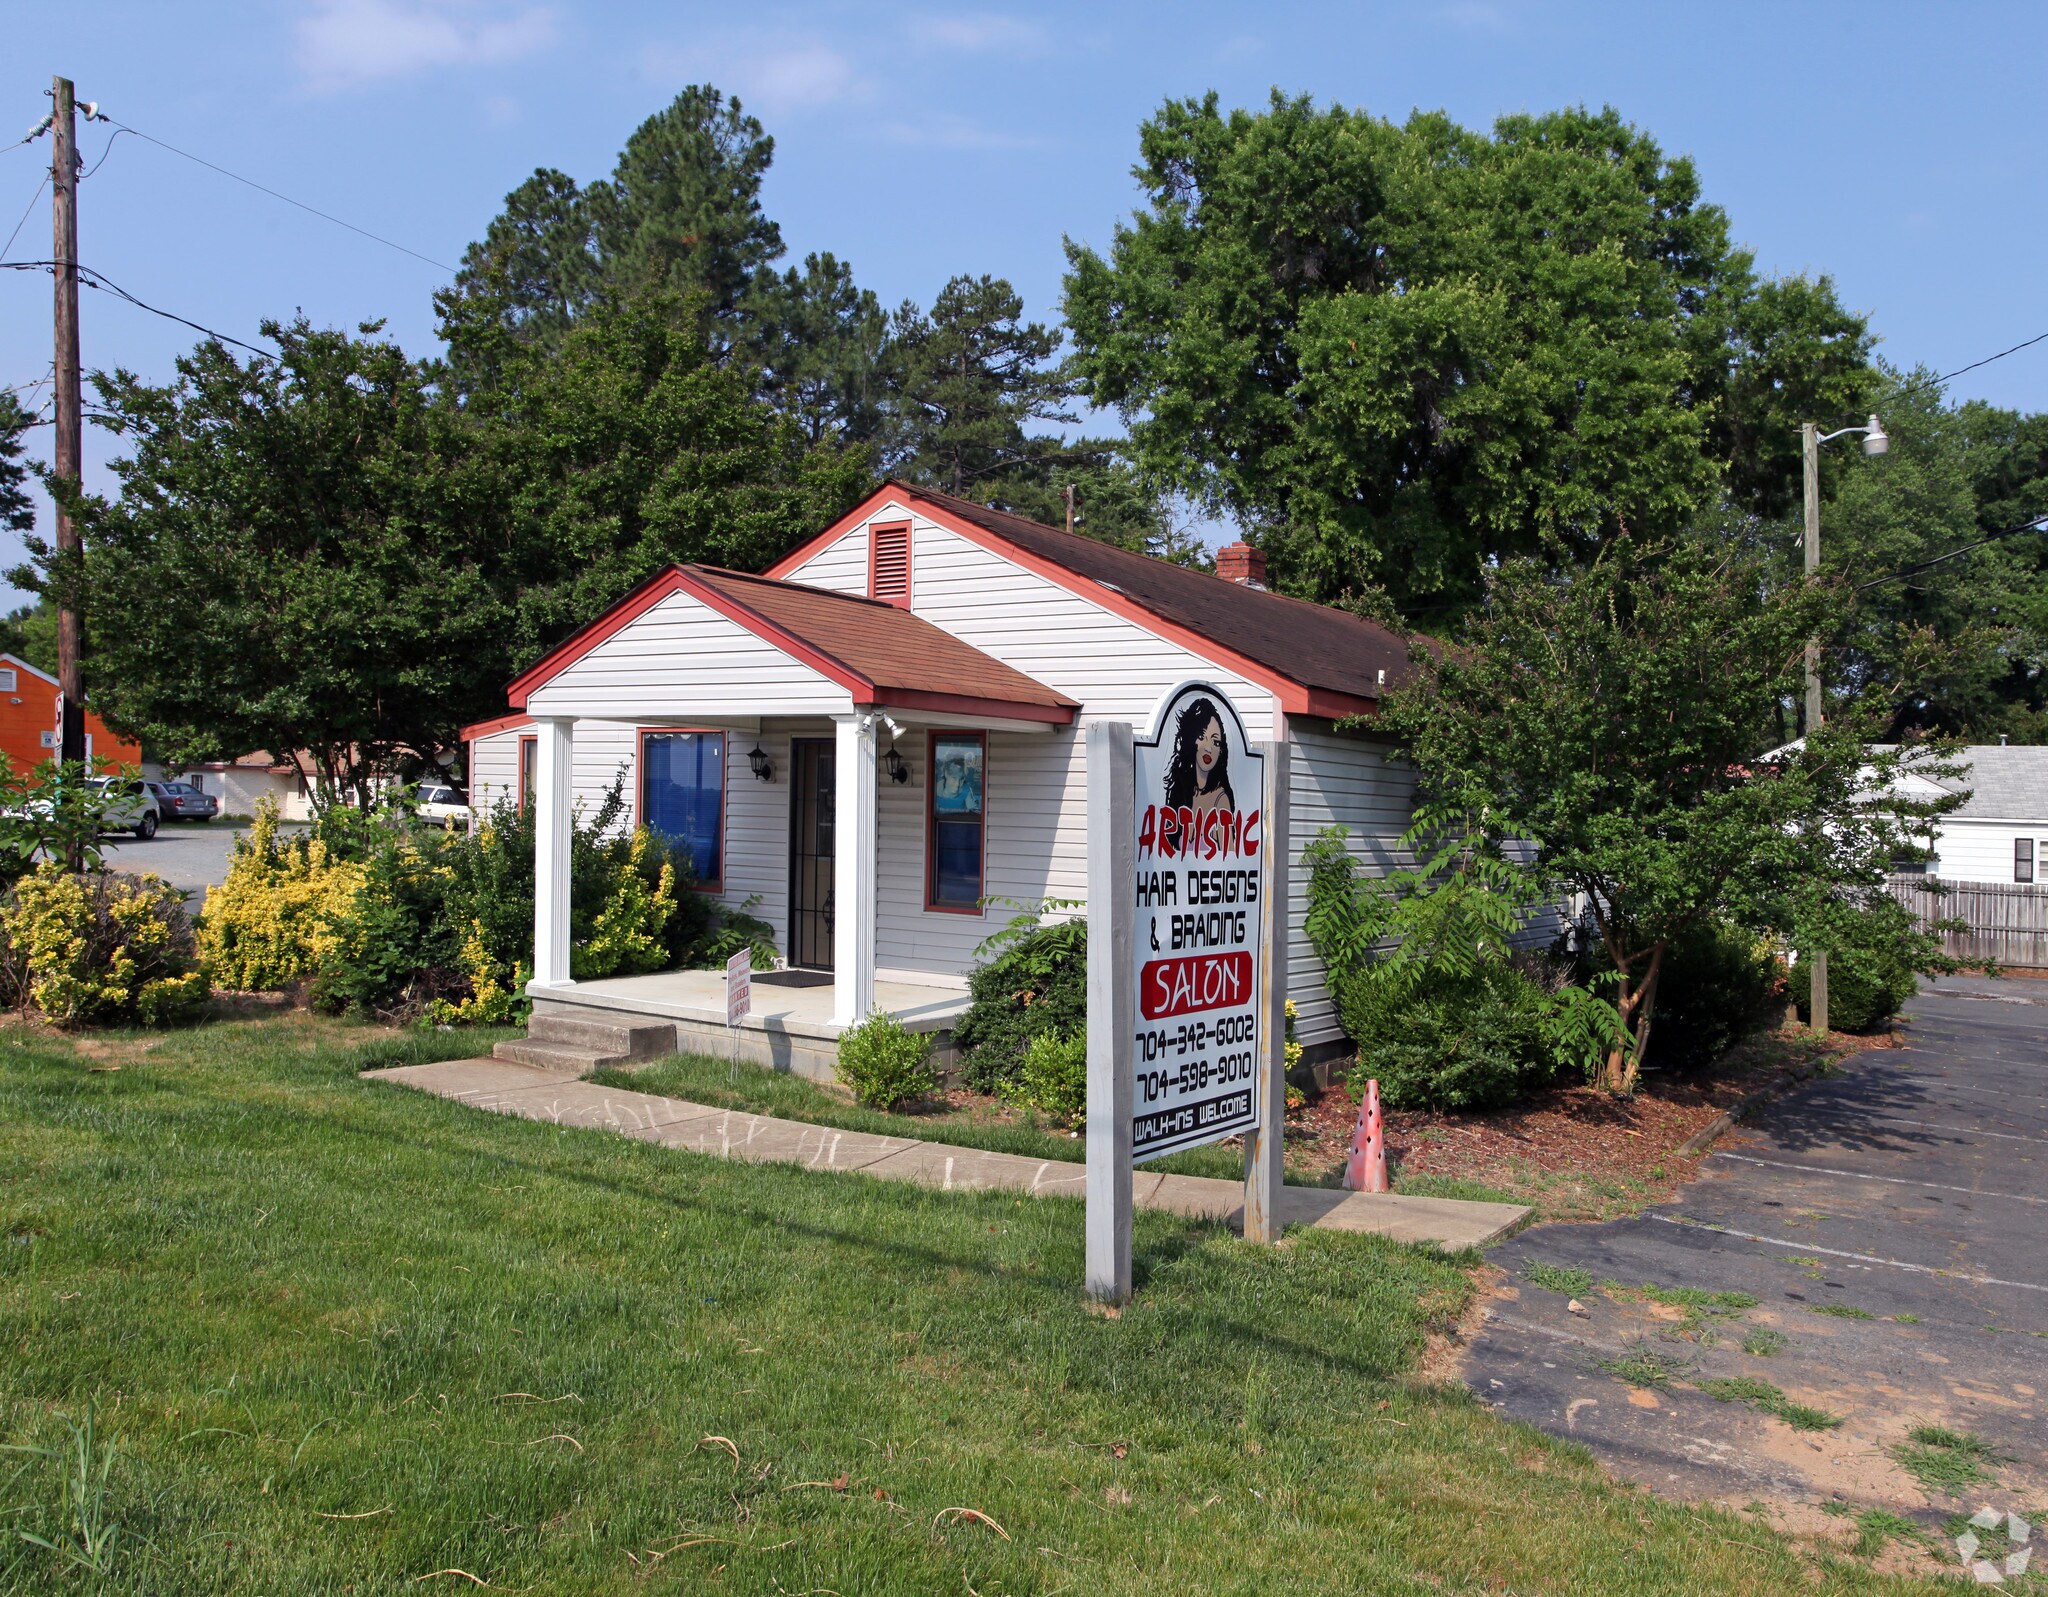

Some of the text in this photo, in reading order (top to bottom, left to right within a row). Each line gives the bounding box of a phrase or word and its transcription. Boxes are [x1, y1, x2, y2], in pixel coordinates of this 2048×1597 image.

[1138, 804, 1259, 862] ARTISTIC
[1137, 870, 1258, 908] HAIR DESIGNS
[1150, 911, 1246, 953] & BRAIDING
[1154, 957, 1240, 1013] SALON
[1135, 1014, 1254, 1062] 704-342-6002
[1137, 1051, 1252, 1103] 704-598-9010
[1134, 1094, 1248, 1142] WALK-INS WELCOME
